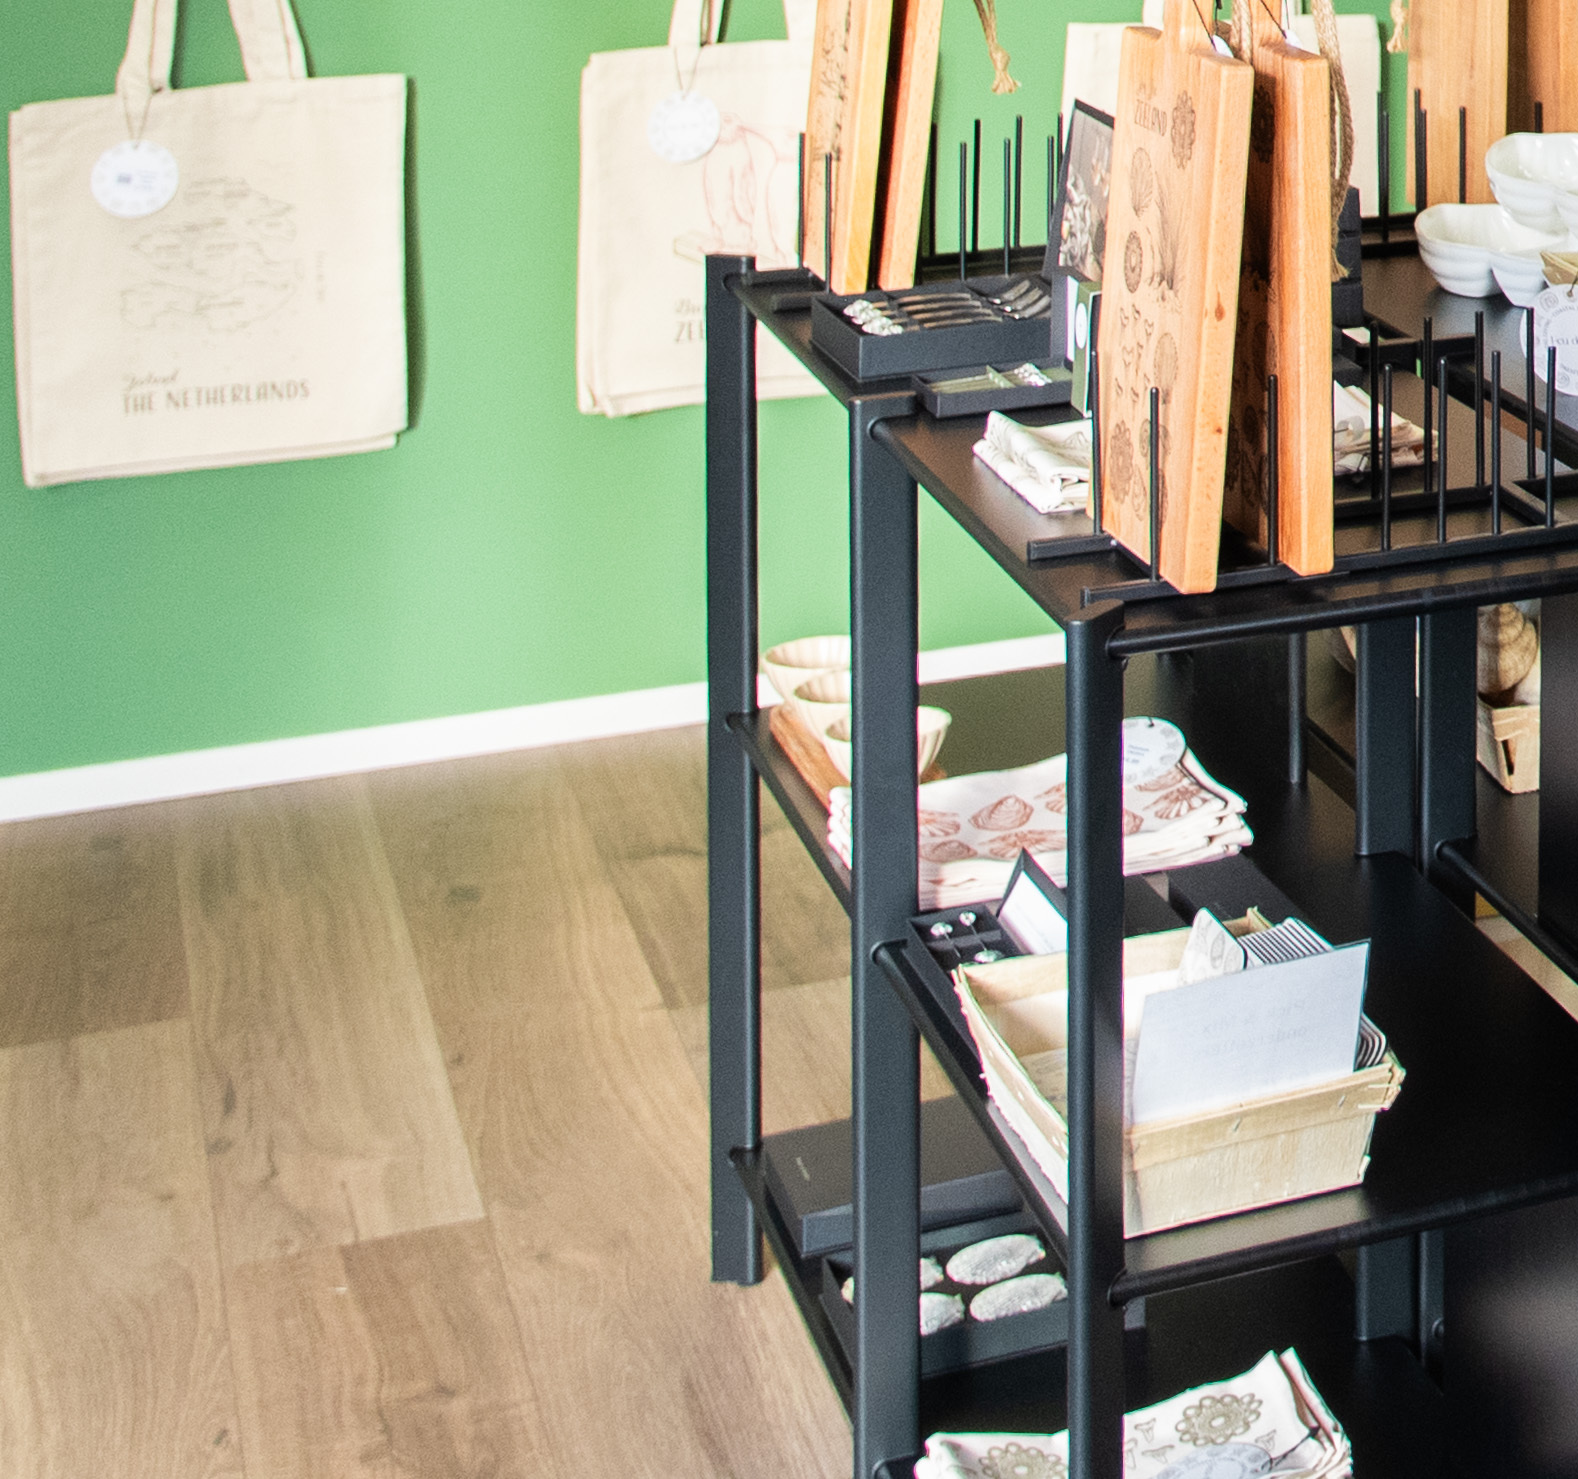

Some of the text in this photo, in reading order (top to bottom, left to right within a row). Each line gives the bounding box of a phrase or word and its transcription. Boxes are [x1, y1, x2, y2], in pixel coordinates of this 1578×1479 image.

[1134, 99, 1167, 136] ZEELAND
[123, 379, 311, 415] THE NETHERLANDS
